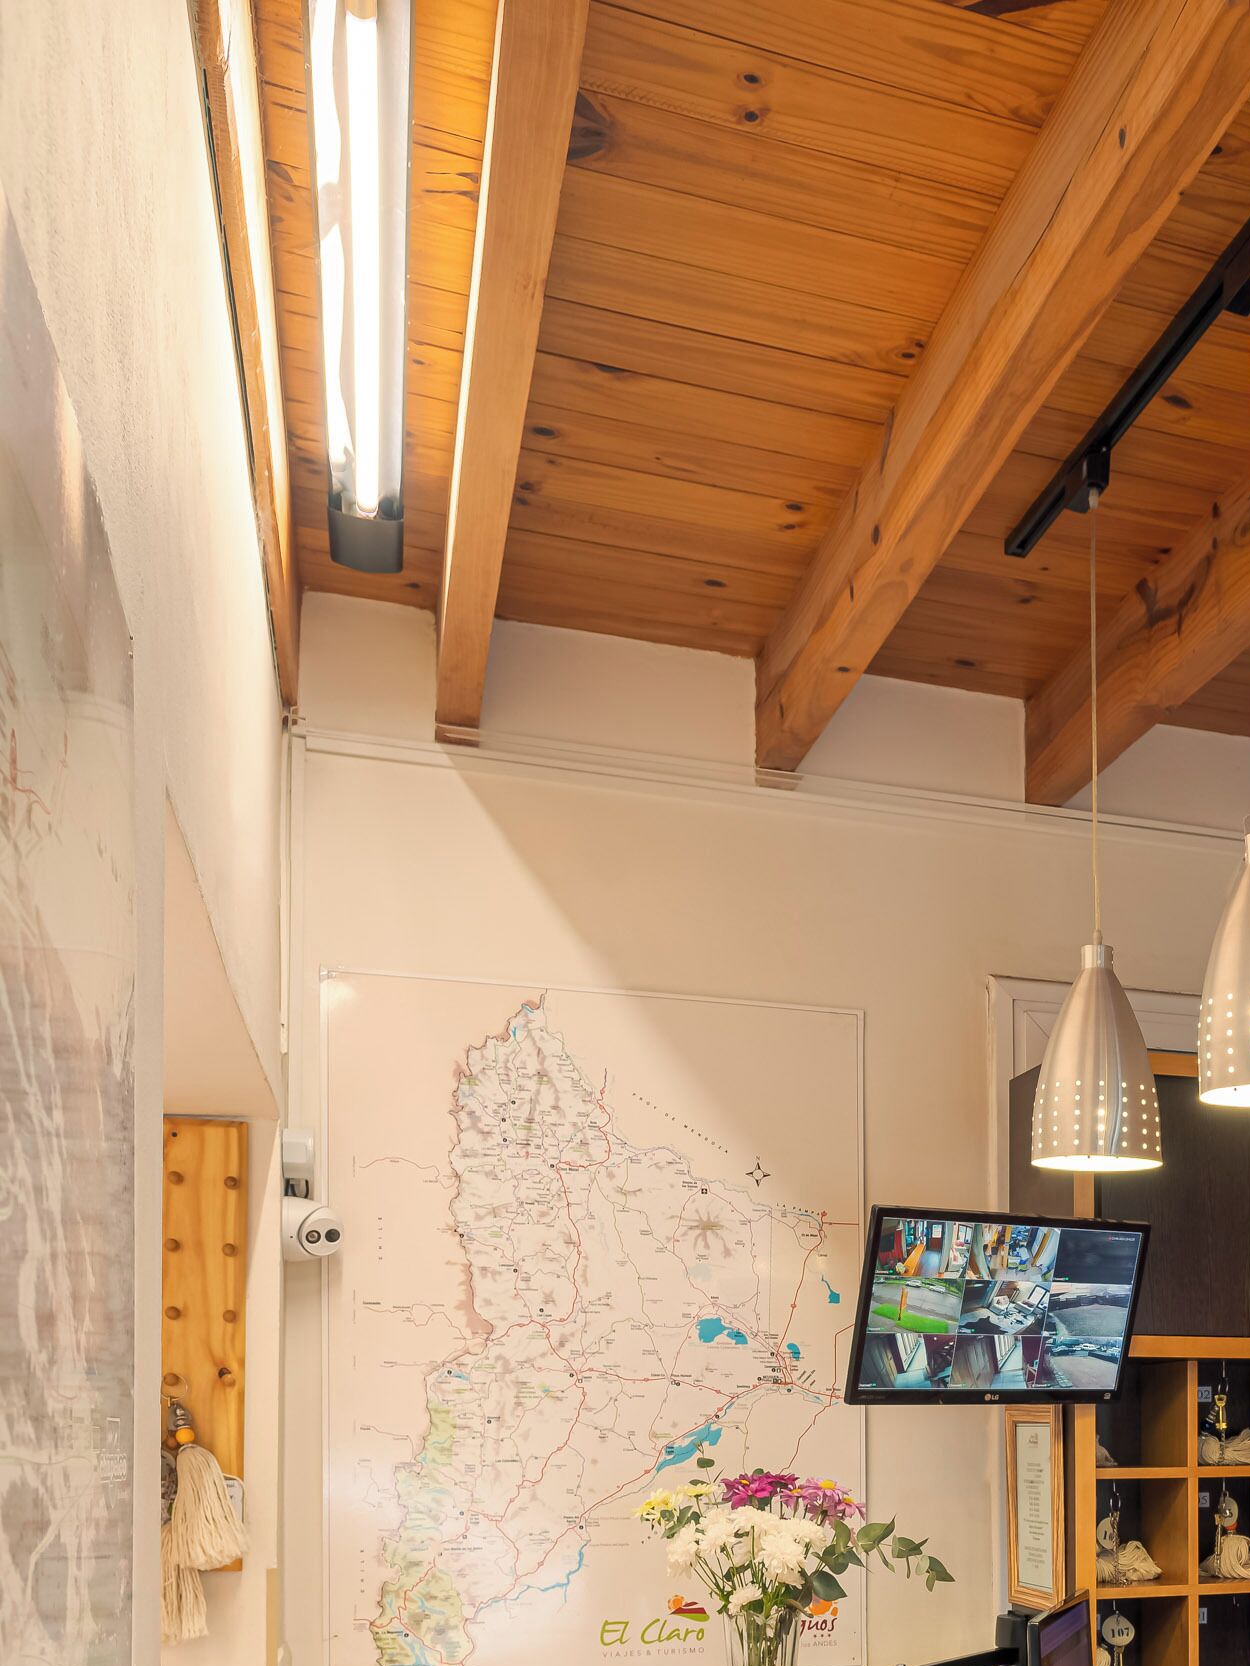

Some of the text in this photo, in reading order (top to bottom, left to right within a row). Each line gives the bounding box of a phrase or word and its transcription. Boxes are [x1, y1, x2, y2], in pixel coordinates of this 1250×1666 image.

[600, 1618, 704, 1646] El Claro
[1111, 1627, 1130, 1638] 107
[602, 1650, 641, 1658] VIAJES
[657, 1647, 705, 1656] TURISMO
